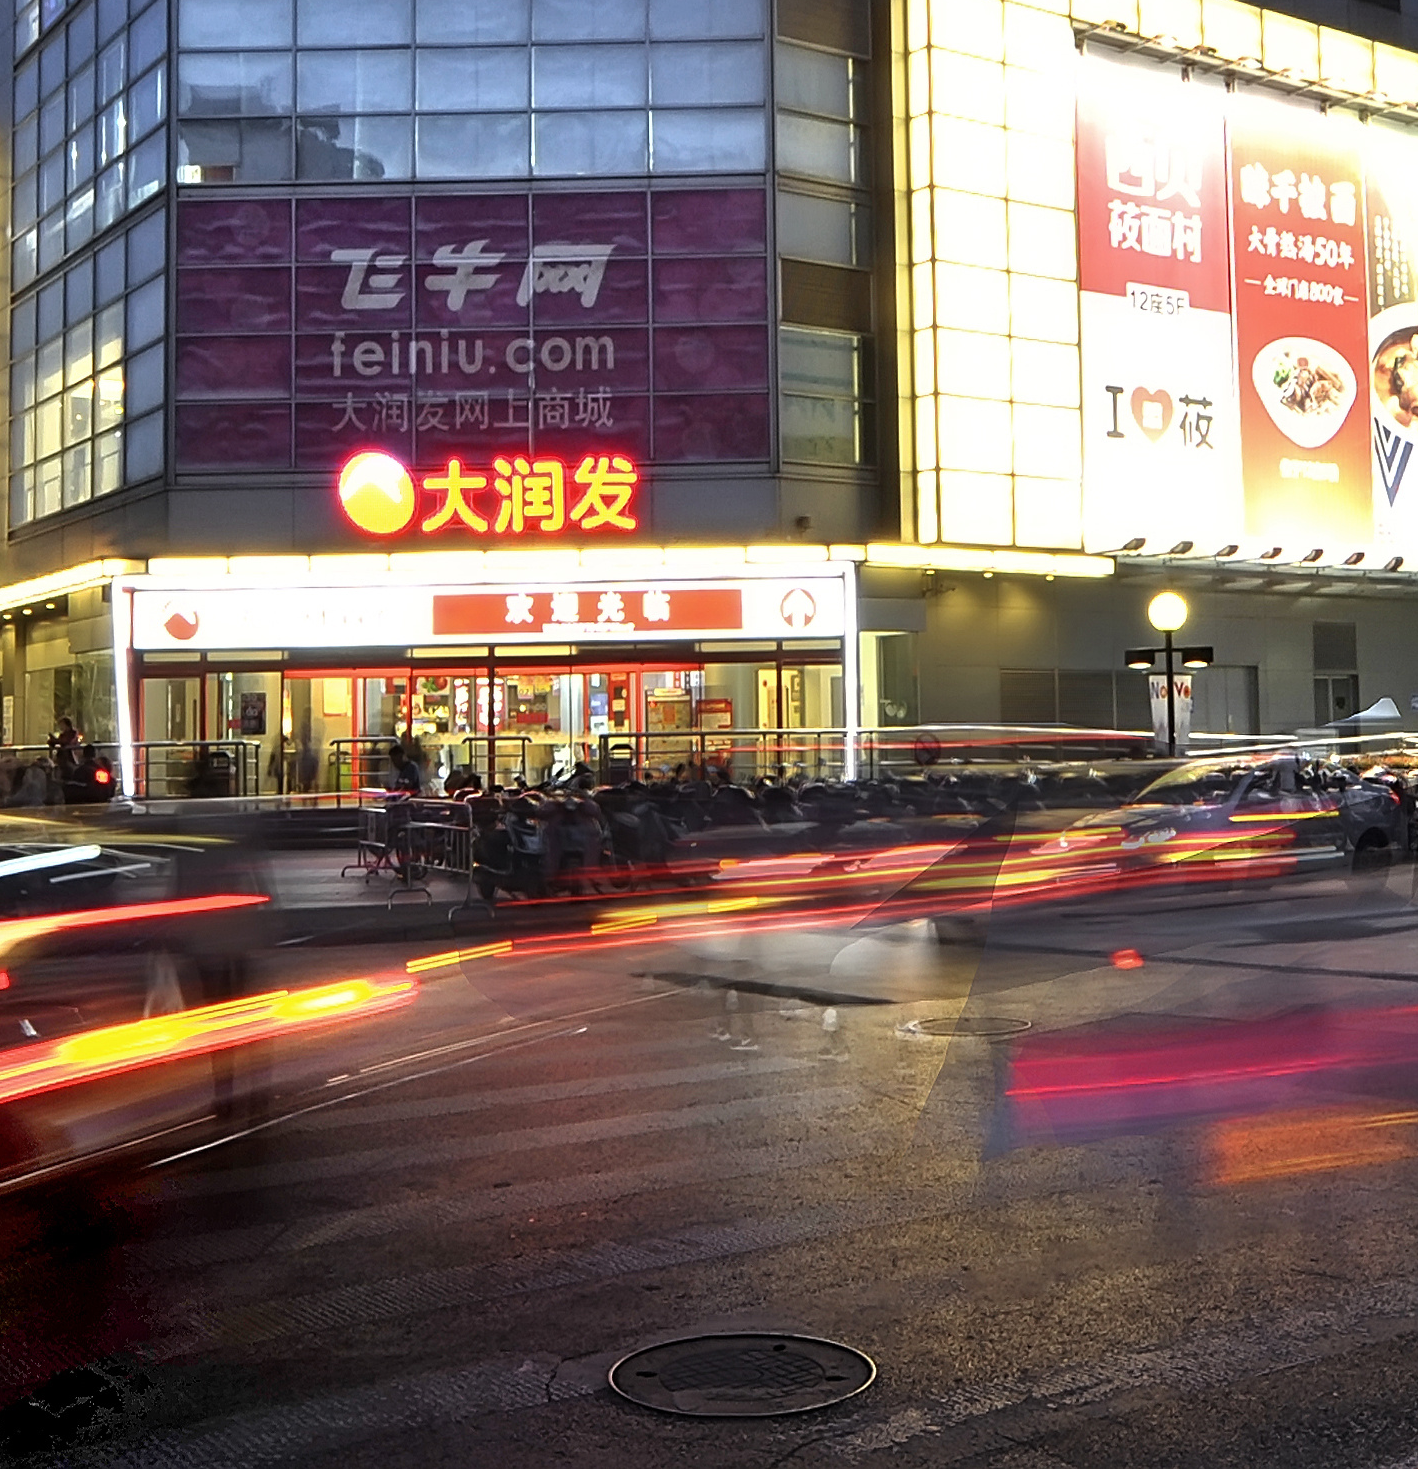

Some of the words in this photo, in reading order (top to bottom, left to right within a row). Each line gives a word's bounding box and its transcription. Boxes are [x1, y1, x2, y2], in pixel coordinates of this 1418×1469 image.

[1107, 199, 1203, 264] 莜面村
[330, 239, 617, 312] 飞牛网
[1130, 290, 1186, 315] 12座5F
[331, 330, 615, 377] feiniu.com
[331, 385, 615, 433] 大润发网上商城
[421, 453, 640, 534] 大润发
[505, 589, 671, 624] 欢迎光临
